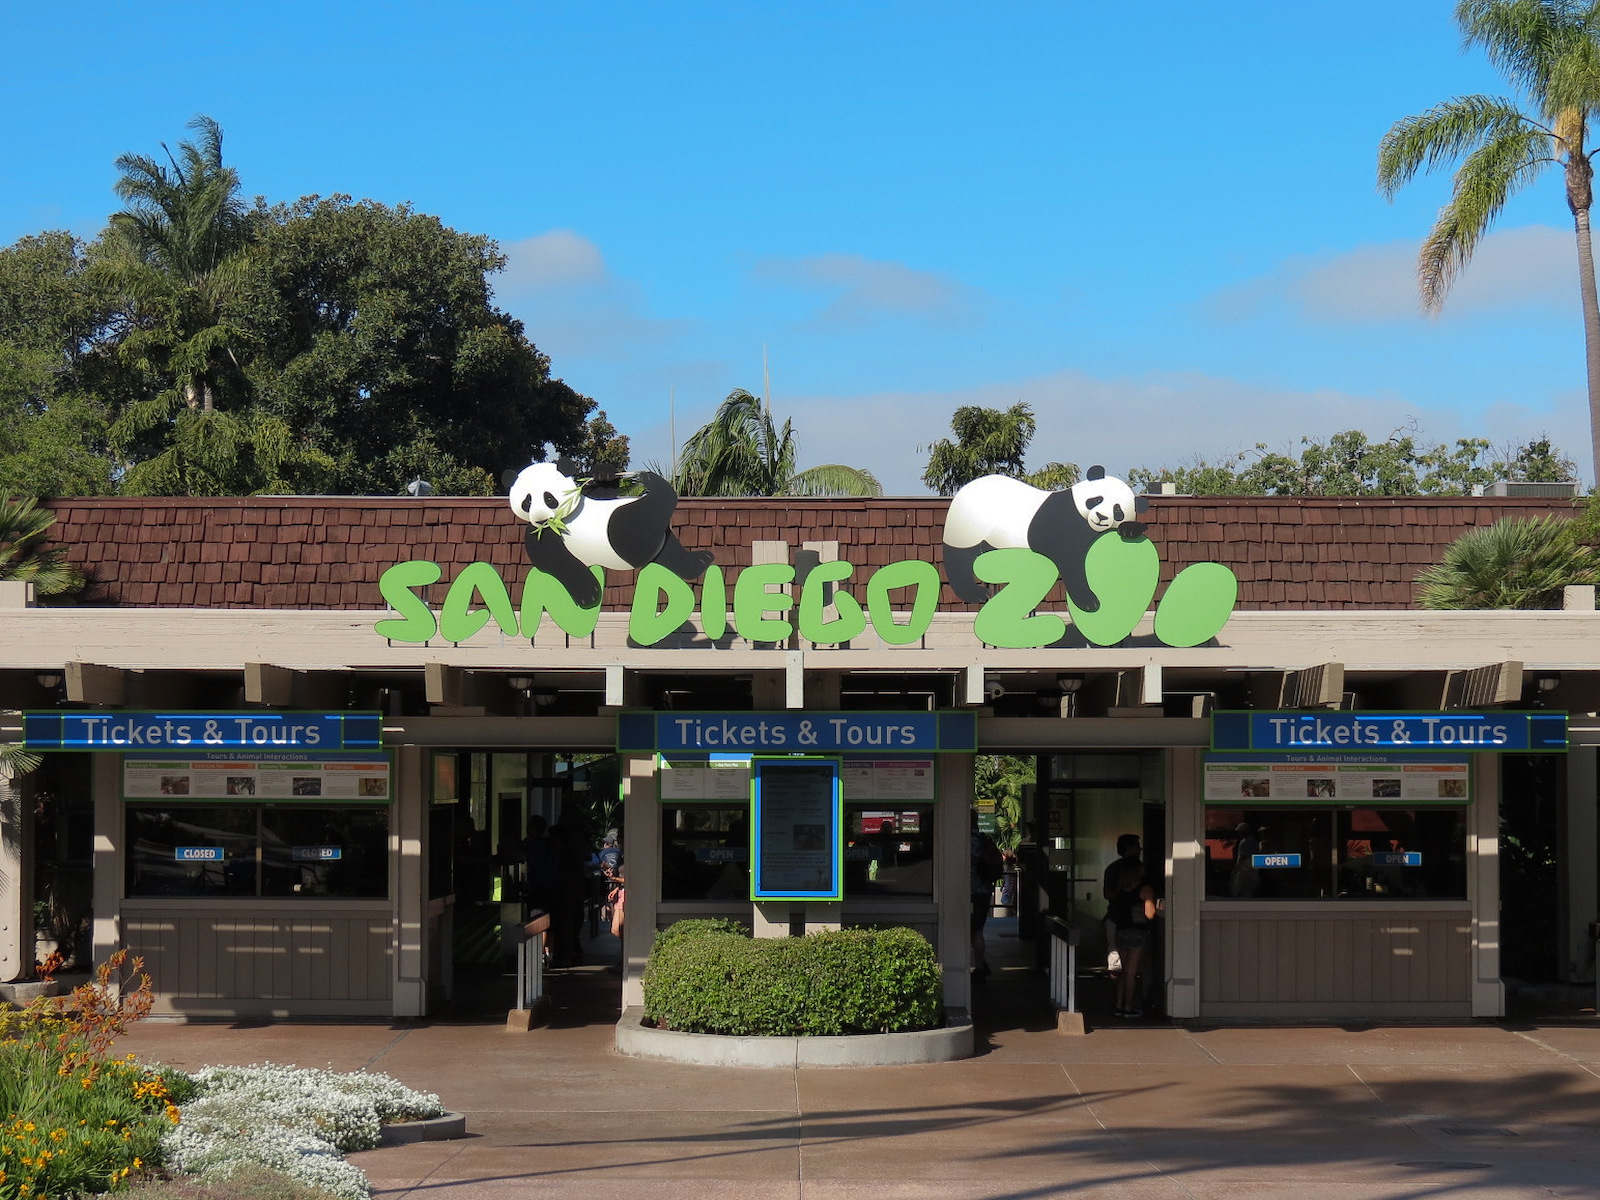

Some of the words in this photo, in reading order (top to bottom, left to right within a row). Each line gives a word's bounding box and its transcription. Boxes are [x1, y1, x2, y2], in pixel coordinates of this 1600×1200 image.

[375, 560, 605, 643] SAN
[629, 560, 941, 646] DIEGO
[974, 530, 1238, 648] ZOO
[82, 719, 192, 744] Tickets
[203, 719, 226, 744] &
[235, 719, 321, 744] Tours
[676, 720, 786, 745] Tickets
[797, 720, 820, 745] &
[829, 720, 915, 745] Tours
[1269, 719, 1379, 744] Tickets
[1390, 719, 1413, 744] &
[1422, 719, 1508, 744] Tours
[264, 753, 308, 761] Interactions
[1286, 754, 1307, 762] Tours
[1309, 754, 1315, 762] &
[1317, 754, 1342, 762] Animal
[183, 848, 216, 859] CLOSED
[301, 847, 333, 858] CLOSED
[709, 849, 734, 859] OPEN
[1264, 856, 1288, 866] OPEN
[1385, 853, 1409, 864] OPEN
